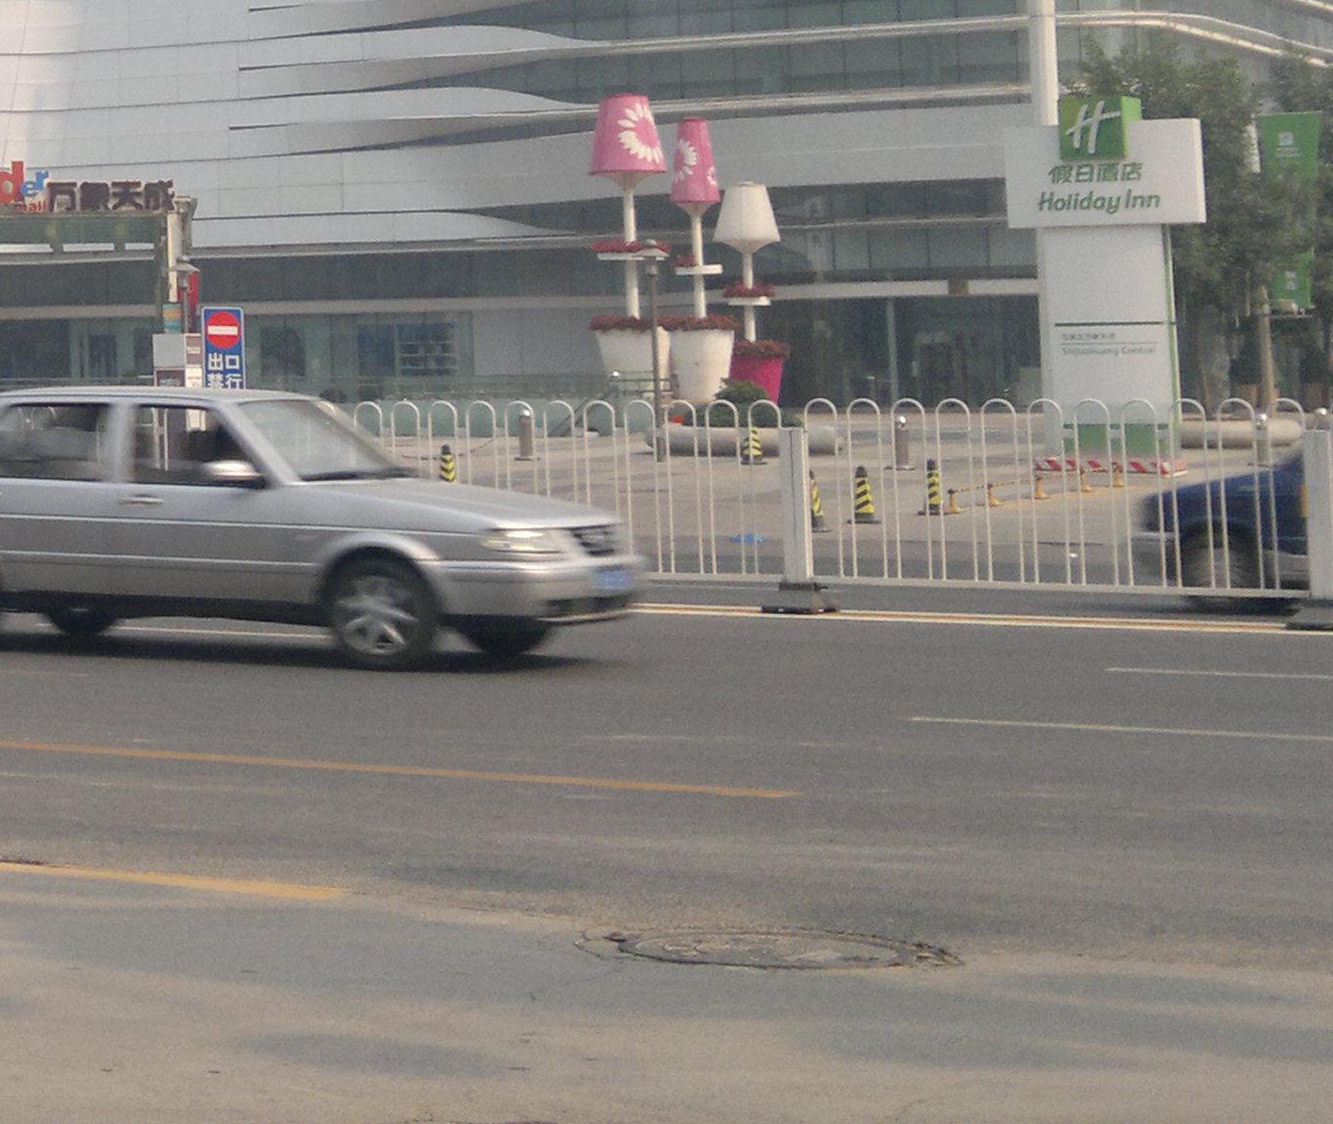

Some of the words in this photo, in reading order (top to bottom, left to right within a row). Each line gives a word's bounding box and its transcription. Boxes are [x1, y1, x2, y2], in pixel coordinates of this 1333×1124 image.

[1048, 162, 1142, 183] 假日酒店
[46, 179, 176, 212] 万象天成
[1038, 190, 1121, 215] Holiday
[1125, 188, 1161, 209] Inn
[208, 353, 240, 370] 出口
